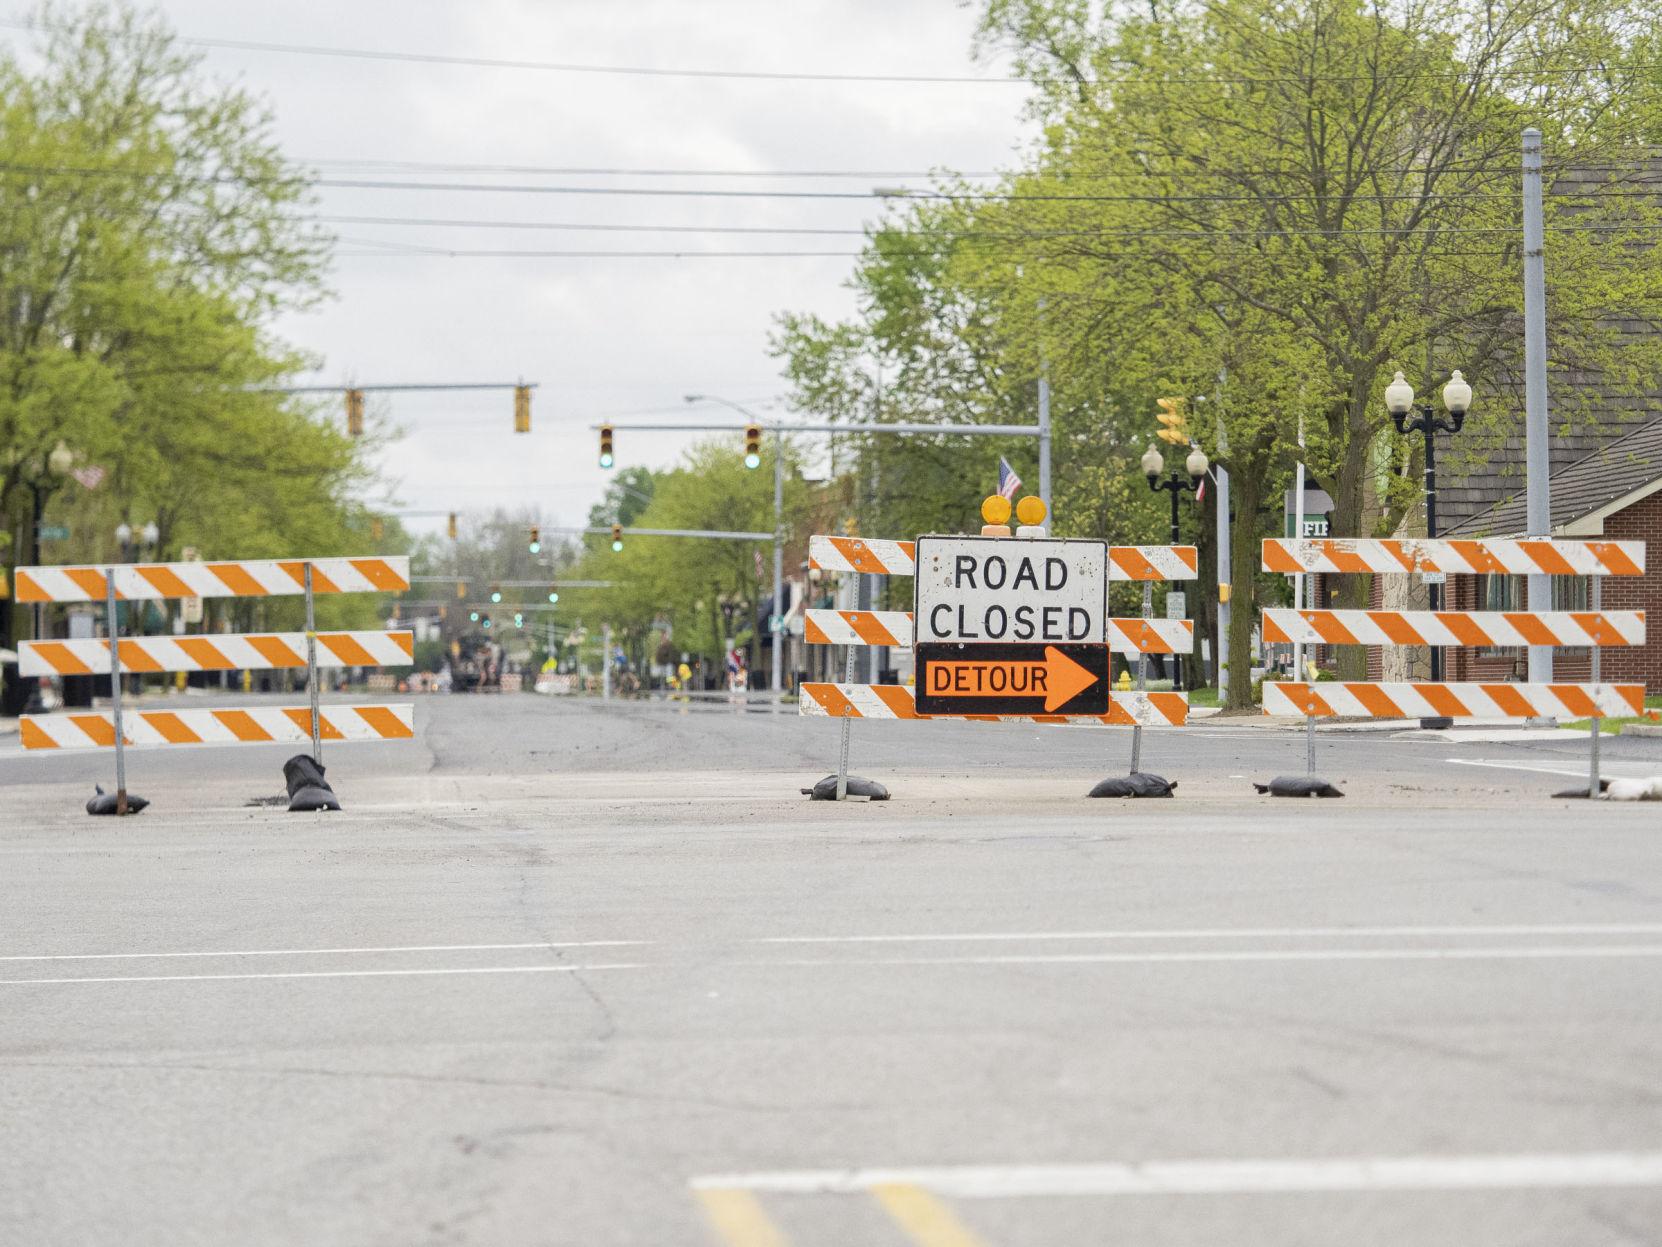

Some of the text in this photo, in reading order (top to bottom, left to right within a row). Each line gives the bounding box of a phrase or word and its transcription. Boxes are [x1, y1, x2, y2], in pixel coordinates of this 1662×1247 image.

[954, 555, 1068, 591] ROAD
[930, 603, 1091, 641] CLOSED
[933, 665, 1048, 692] DETOUR
